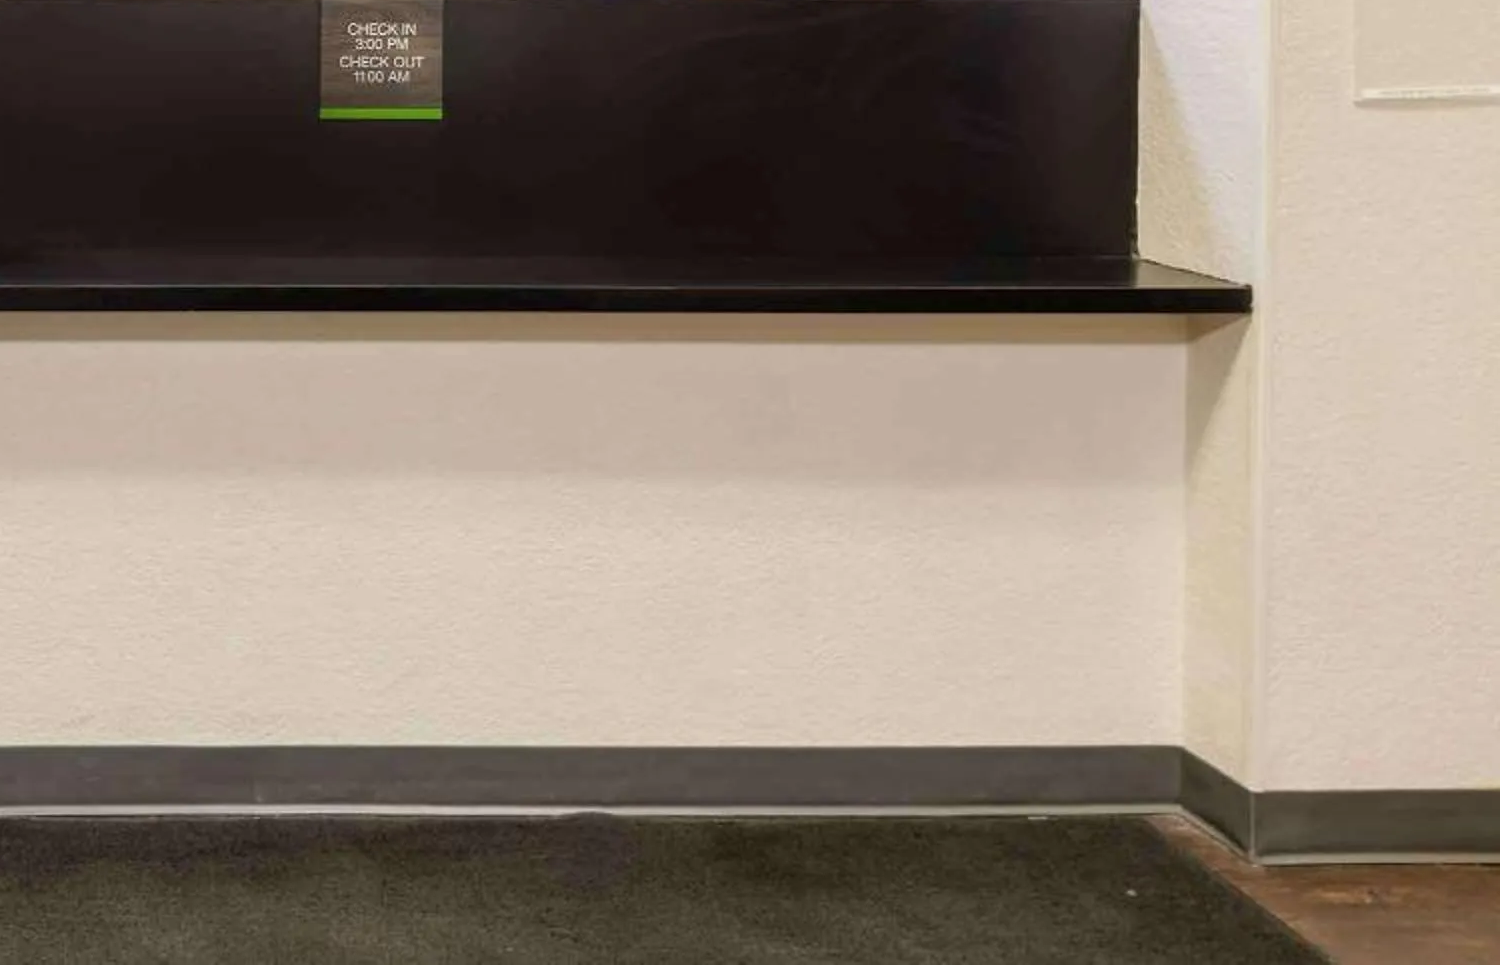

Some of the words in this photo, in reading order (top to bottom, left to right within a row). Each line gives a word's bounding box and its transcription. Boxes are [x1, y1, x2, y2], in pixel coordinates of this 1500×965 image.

[347, 22, 398, 36] CHECK
[401, 22, 417, 36] IN
[355, 38, 383, 50] 3:00
[387, 38, 409, 50] PM
[339, 55, 389, 68] CHECK
[393, 55, 425, 68] OUT
[353, 70, 385, 83] 1100
[387, 70, 410, 83] AM
